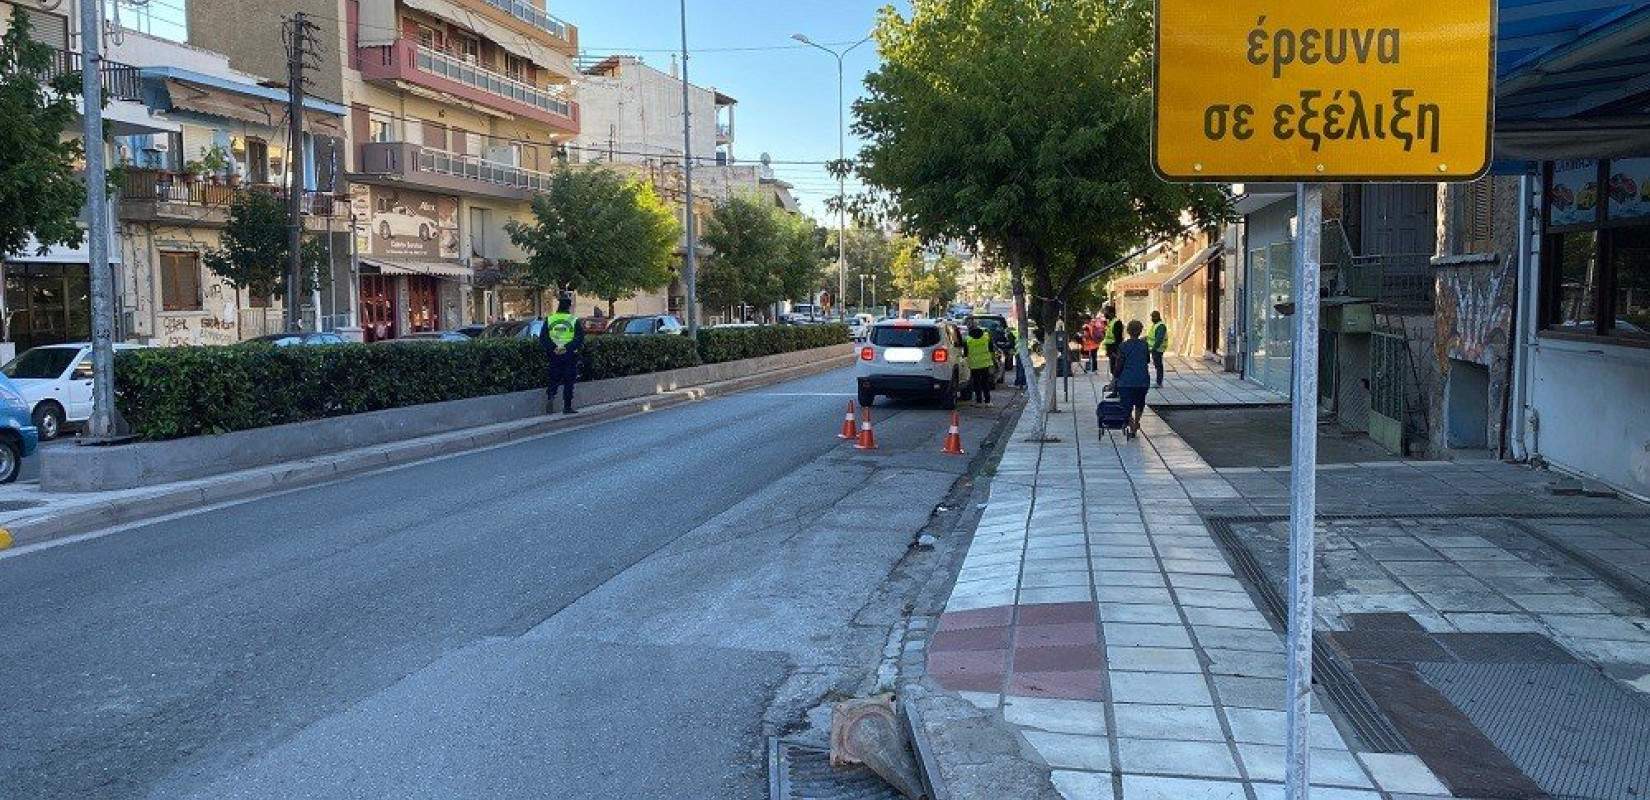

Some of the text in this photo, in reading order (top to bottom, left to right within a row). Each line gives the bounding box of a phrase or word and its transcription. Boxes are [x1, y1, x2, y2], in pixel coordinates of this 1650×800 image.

[1247, 16, 1400, 79] έρευνα
[1203, 89, 1440, 153] σε εξέλιξη
